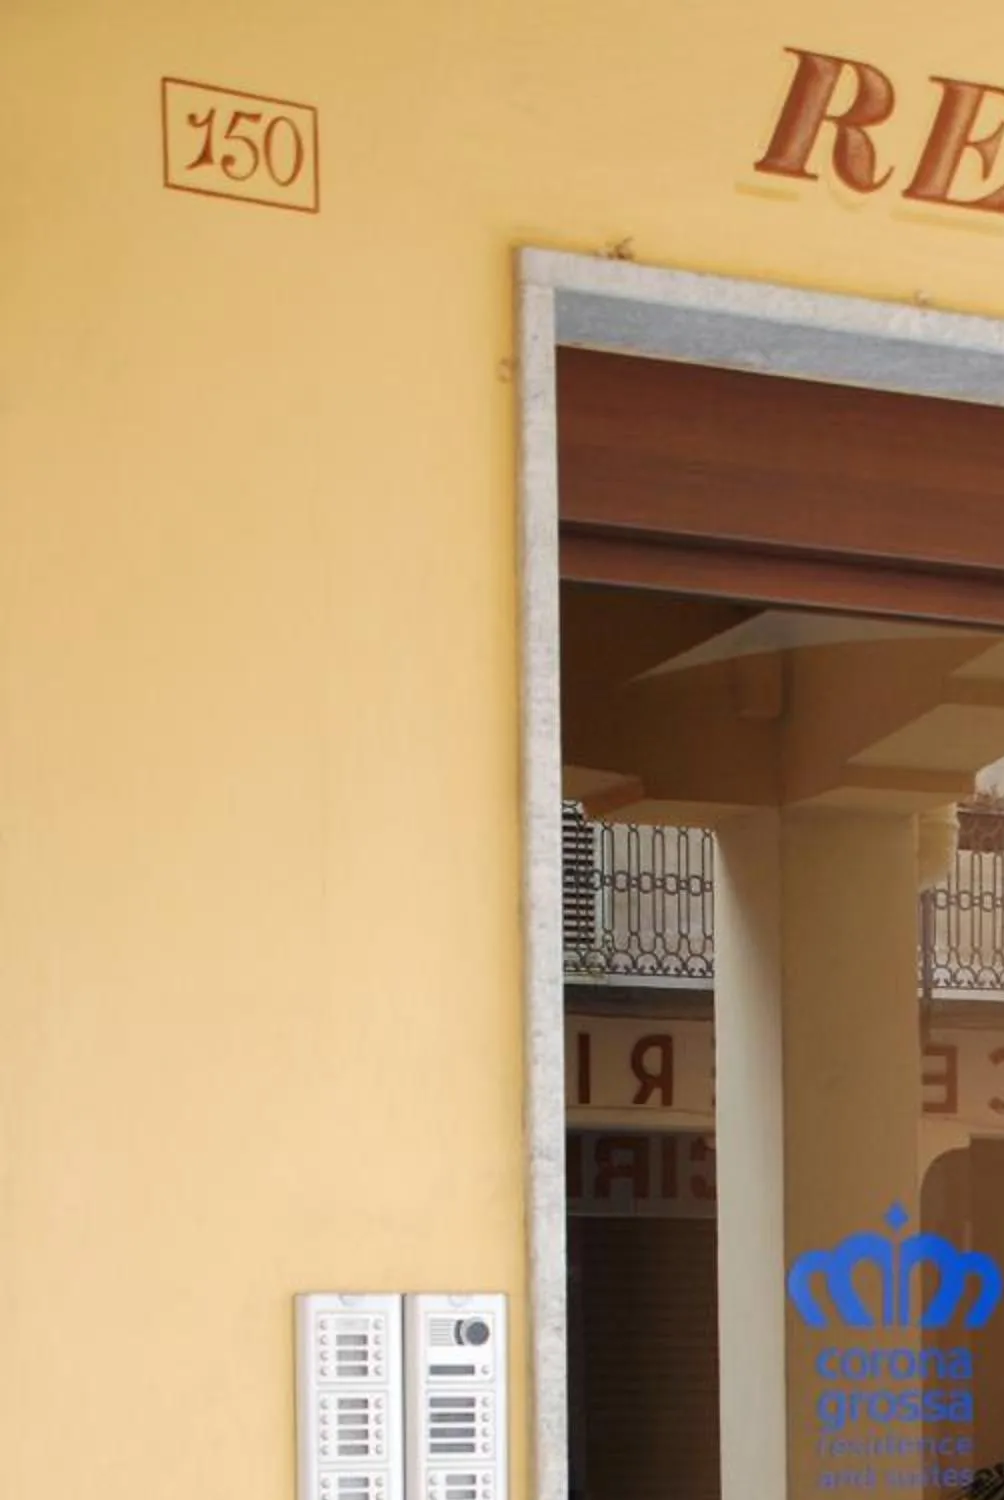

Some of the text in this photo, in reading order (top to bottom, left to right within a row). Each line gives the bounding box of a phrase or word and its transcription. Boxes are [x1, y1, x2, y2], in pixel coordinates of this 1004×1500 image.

[185, 106, 304, 187] 150
[815, 1346, 974, 1380] corona
[815, 1387, 975, 1432] grossa
